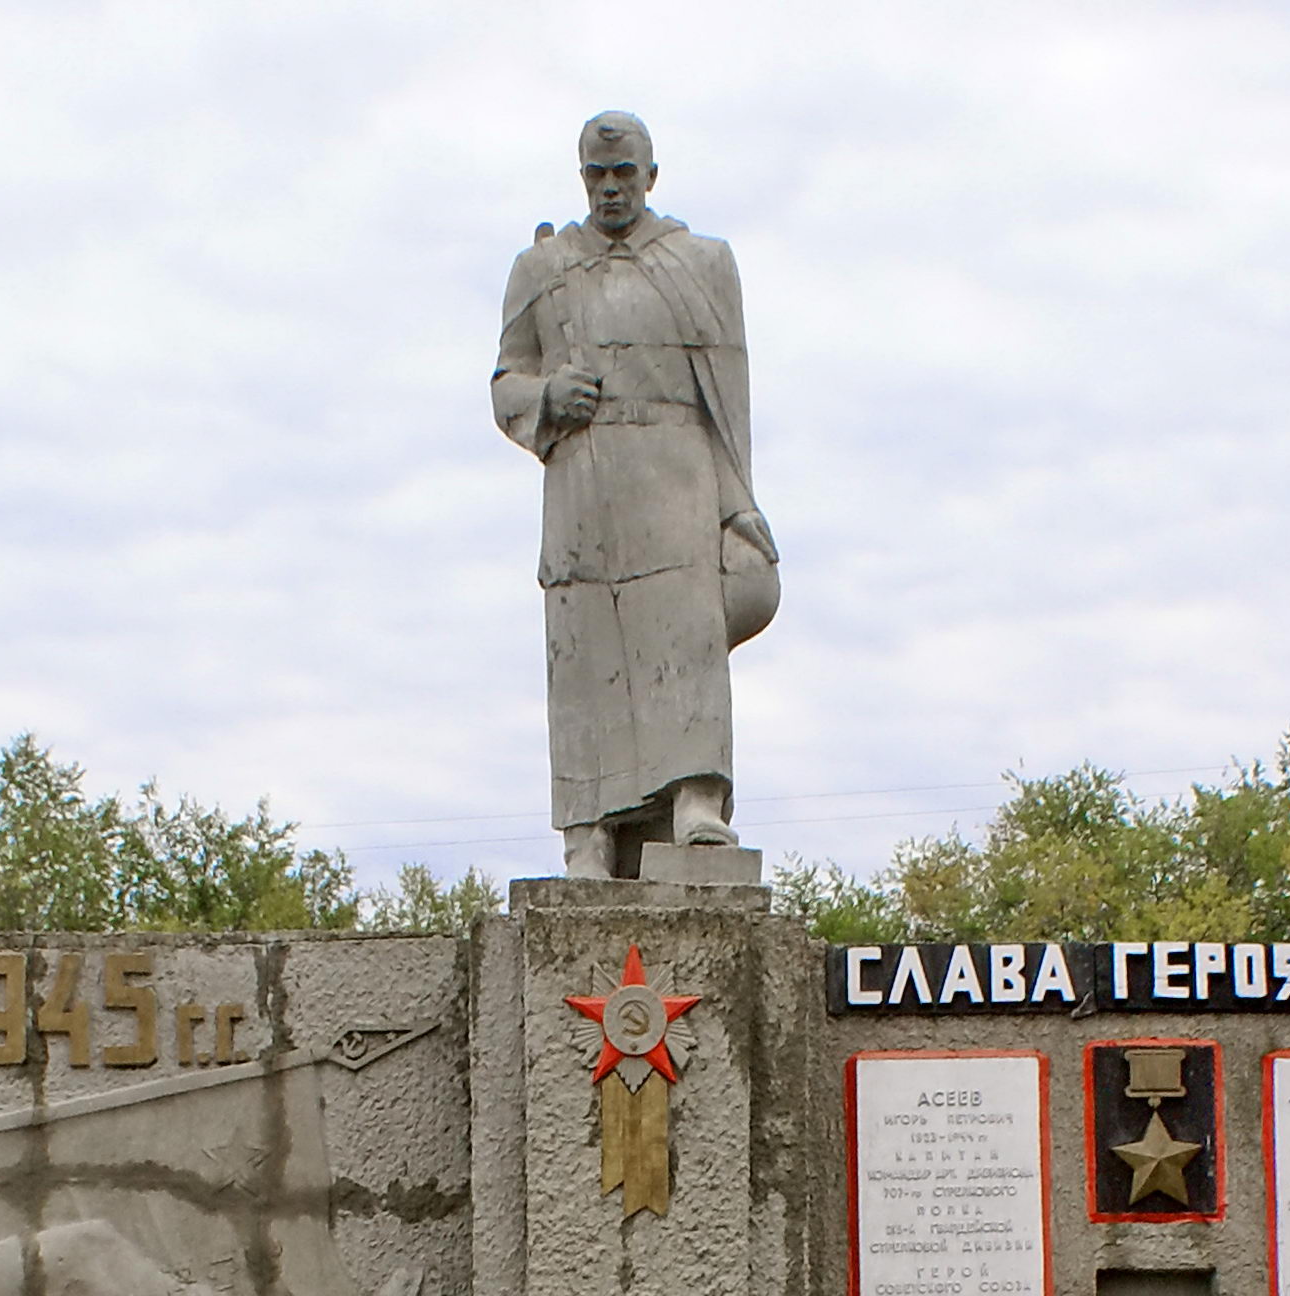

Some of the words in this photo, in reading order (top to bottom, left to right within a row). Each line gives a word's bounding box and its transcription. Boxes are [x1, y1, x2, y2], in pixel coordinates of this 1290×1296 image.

[846, 944, 1076, 1005] СЛАВА
[917, 1090, 983, 1107] АСЕЕВ
[884, 1113, 927, 1126] ИГОРЬ
